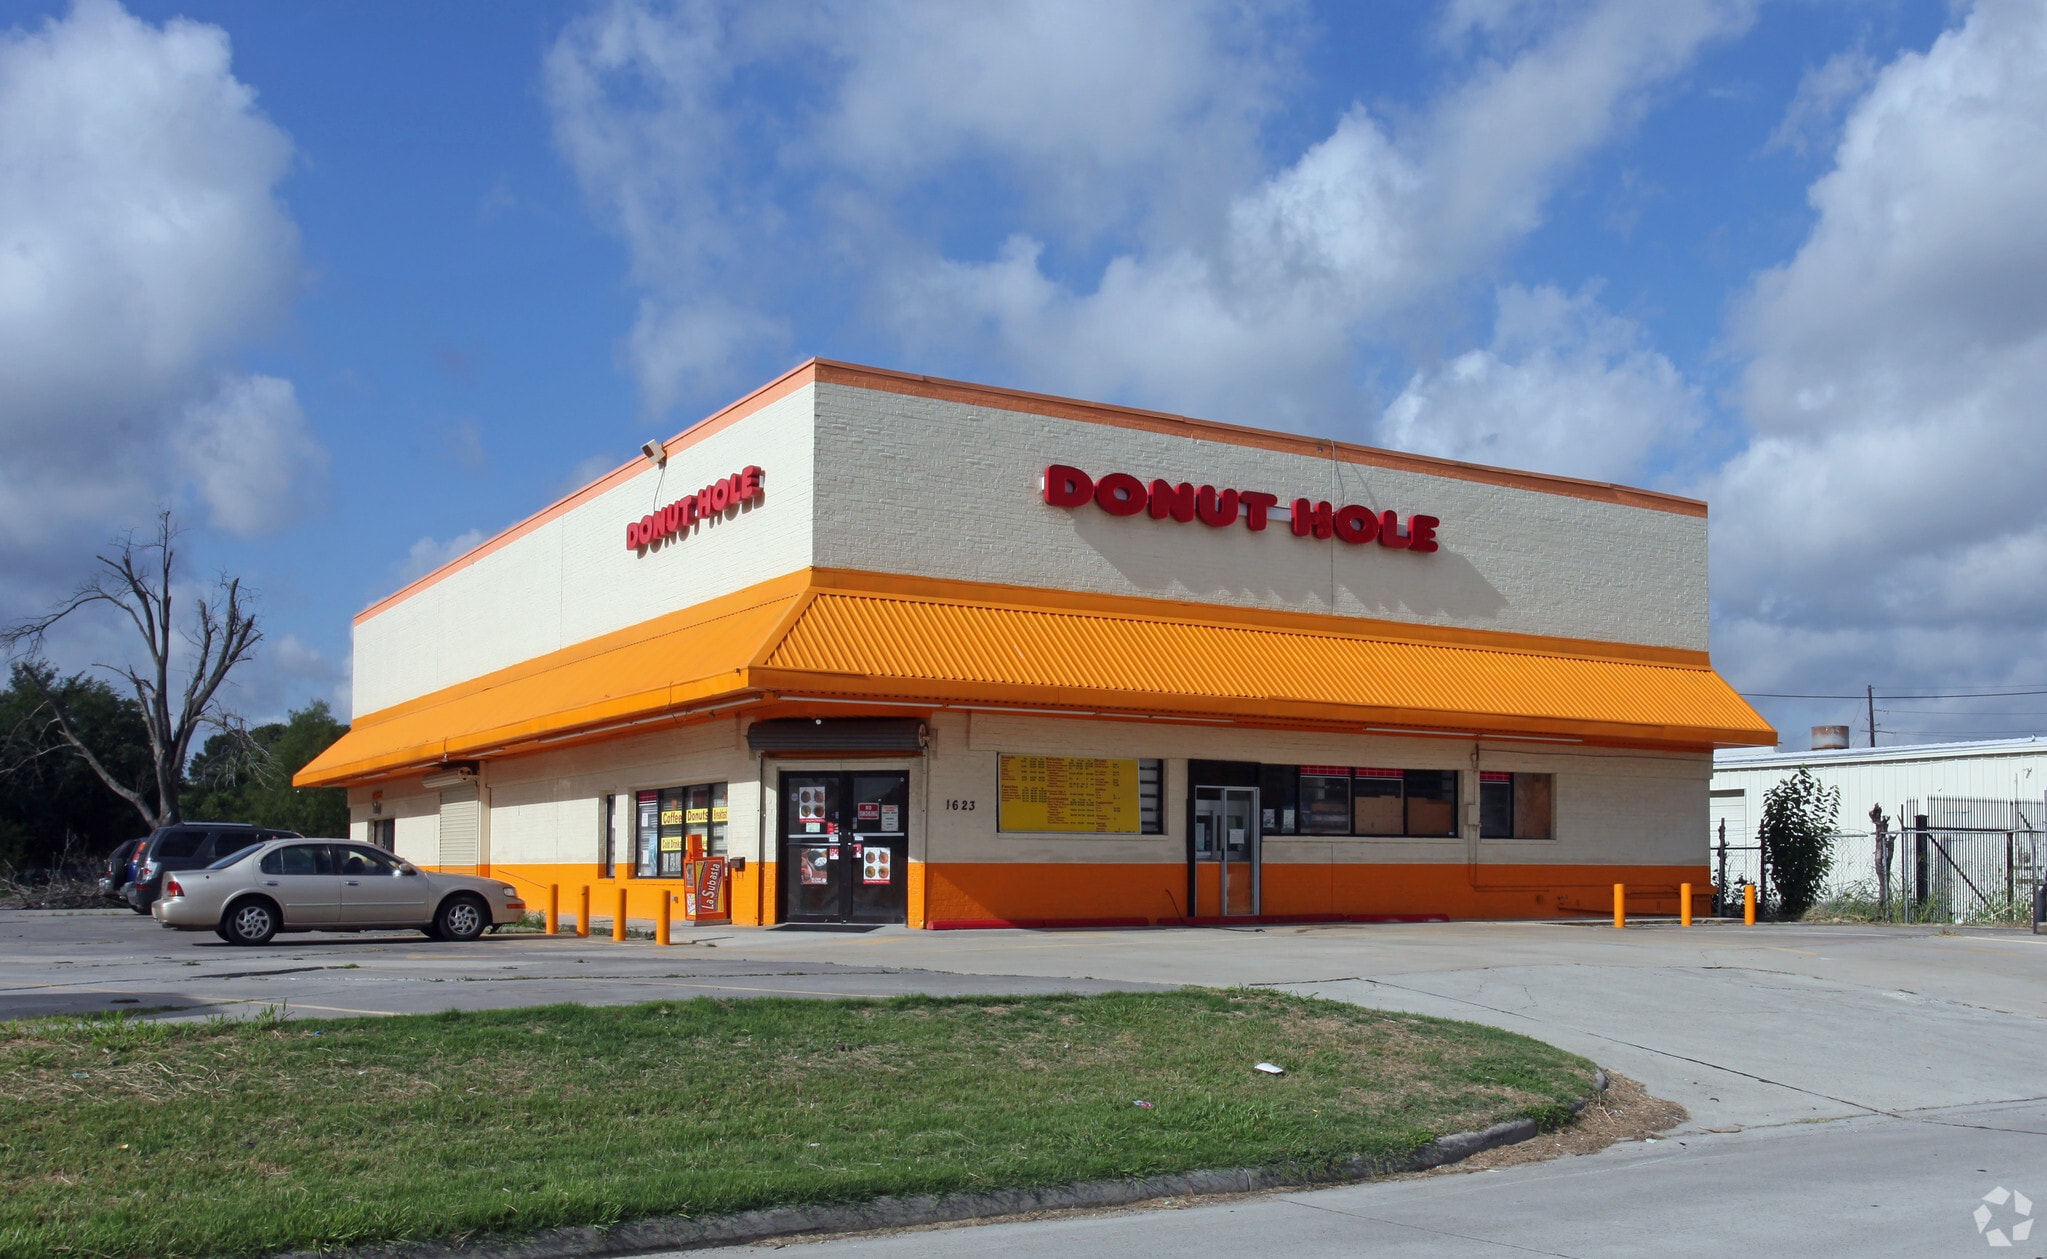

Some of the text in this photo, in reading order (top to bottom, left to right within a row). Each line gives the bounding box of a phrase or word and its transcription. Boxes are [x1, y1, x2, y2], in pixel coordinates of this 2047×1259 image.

[627, 465, 764, 551] DONUT HOLE
[1044, 464, 1439, 553] DONUT HOLE
[663, 812, 683, 824] Coffee
[688, 810, 709, 821] Donuts
[946, 799, 976, 811] 1623
[702, 863, 720, 910] La Subasta
